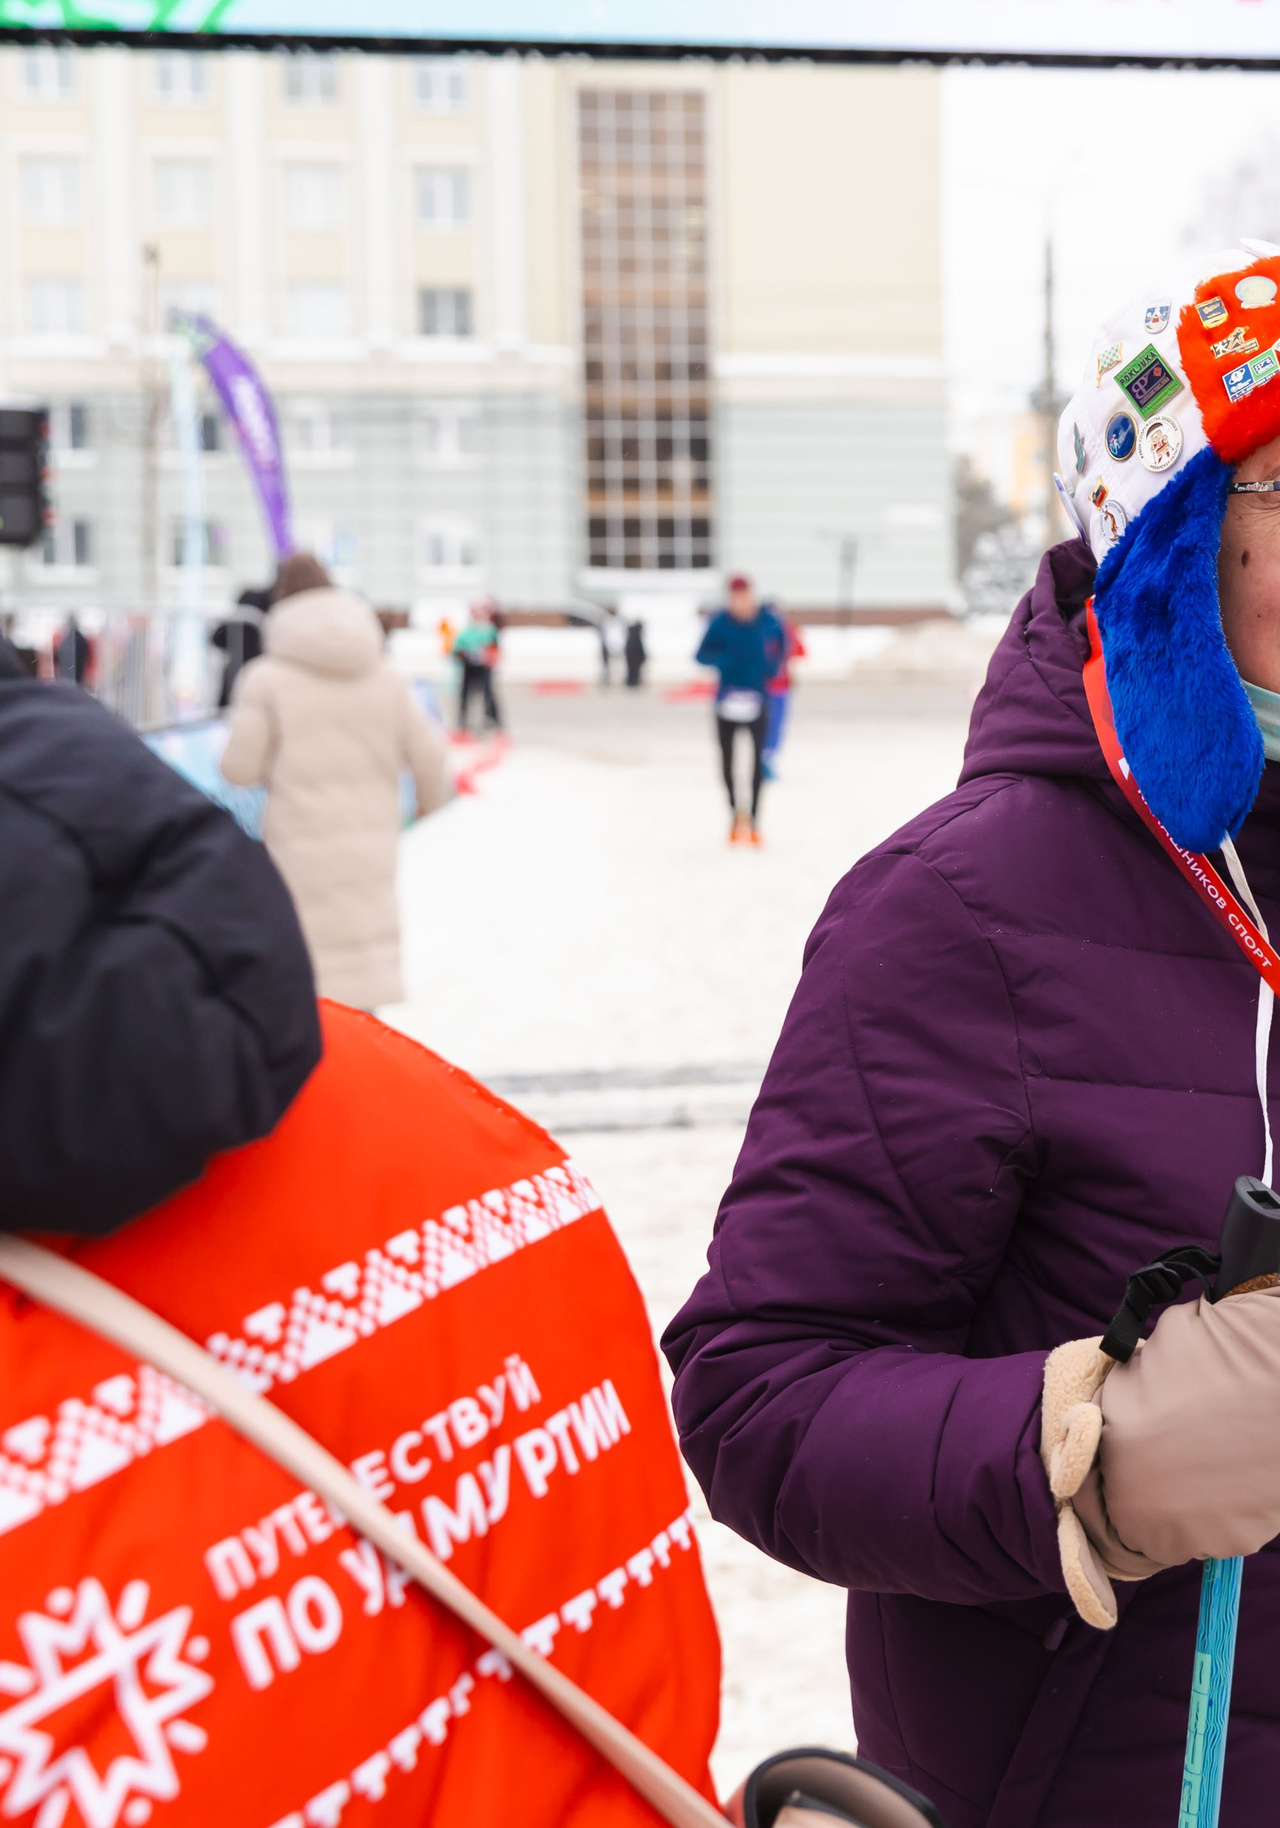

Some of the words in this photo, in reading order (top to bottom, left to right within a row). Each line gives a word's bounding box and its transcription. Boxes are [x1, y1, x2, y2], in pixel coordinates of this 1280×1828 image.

[1119, 351, 1157, 386] POKLJUKA
[1228, 913, 1272, 967] СПОРТ
[204, 1353, 541, 1602] ПУТЕЕСТВУЙ
[231, 1575, 343, 1692] ПО
